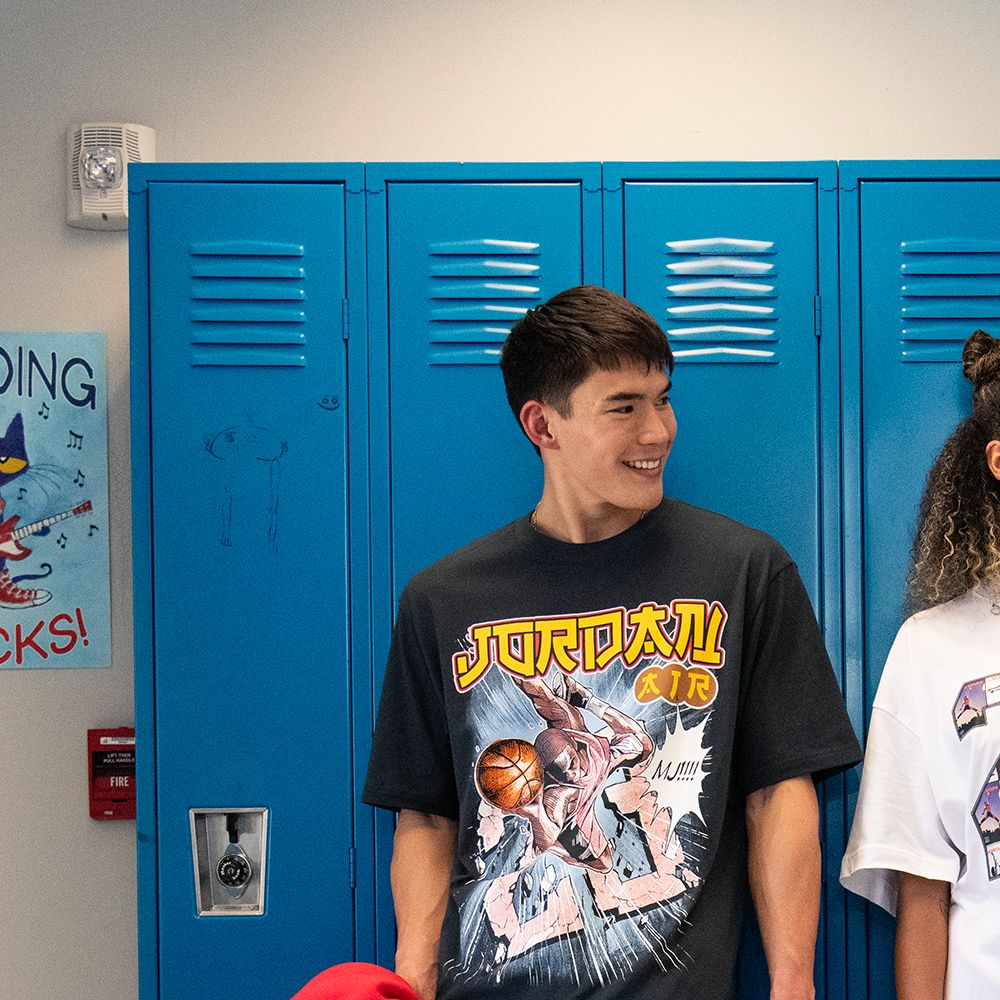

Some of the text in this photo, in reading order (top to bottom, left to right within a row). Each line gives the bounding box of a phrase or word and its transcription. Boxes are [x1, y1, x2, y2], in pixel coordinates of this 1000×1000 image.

[453, 599, 728, 693] JORDAN
[637, 669, 711, 702] AIR
[110, 776, 129, 787] FIRE
